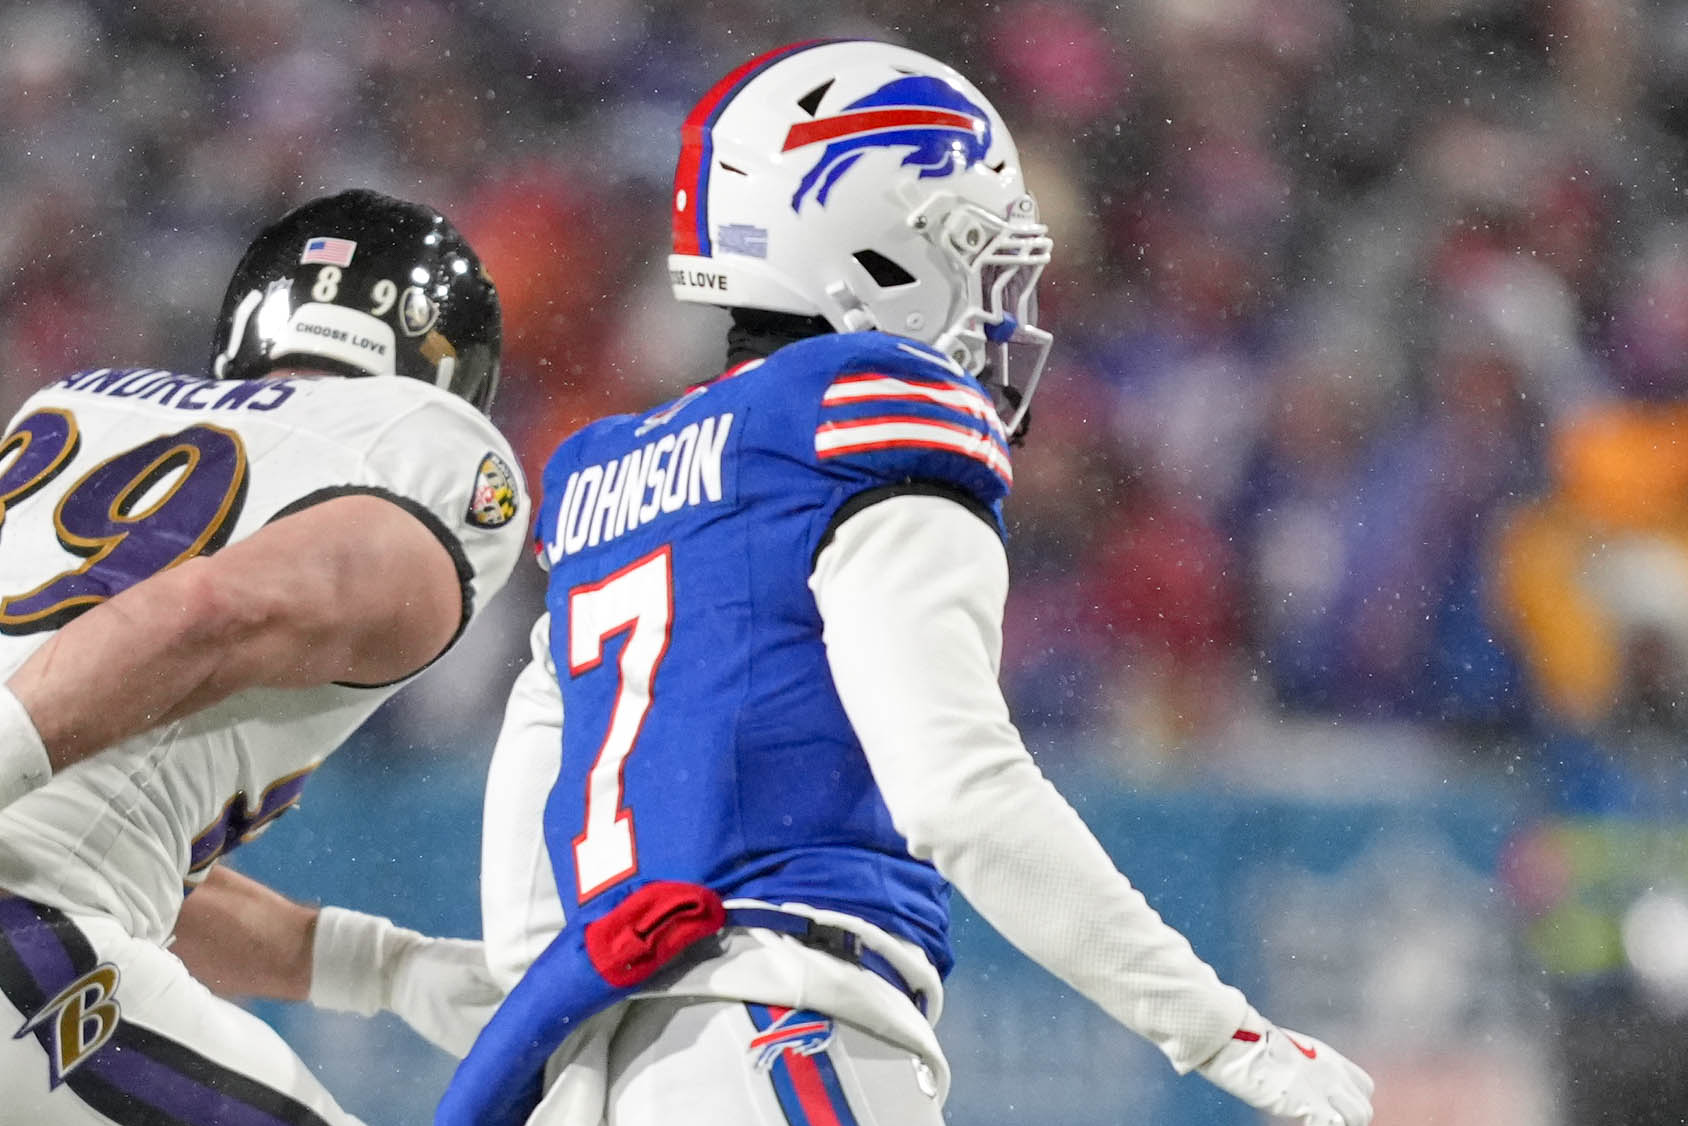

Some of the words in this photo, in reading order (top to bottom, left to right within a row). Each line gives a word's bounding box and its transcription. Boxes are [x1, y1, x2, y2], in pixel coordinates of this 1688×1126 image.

[689, 271, 728, 291] LOVE
[295, 322, 349, 343] CHOOSE
[352, 335, 387, 356] LOVE
[547, 412, 734, 567] JOHNSON
[567, 542, 674, 907] 7
